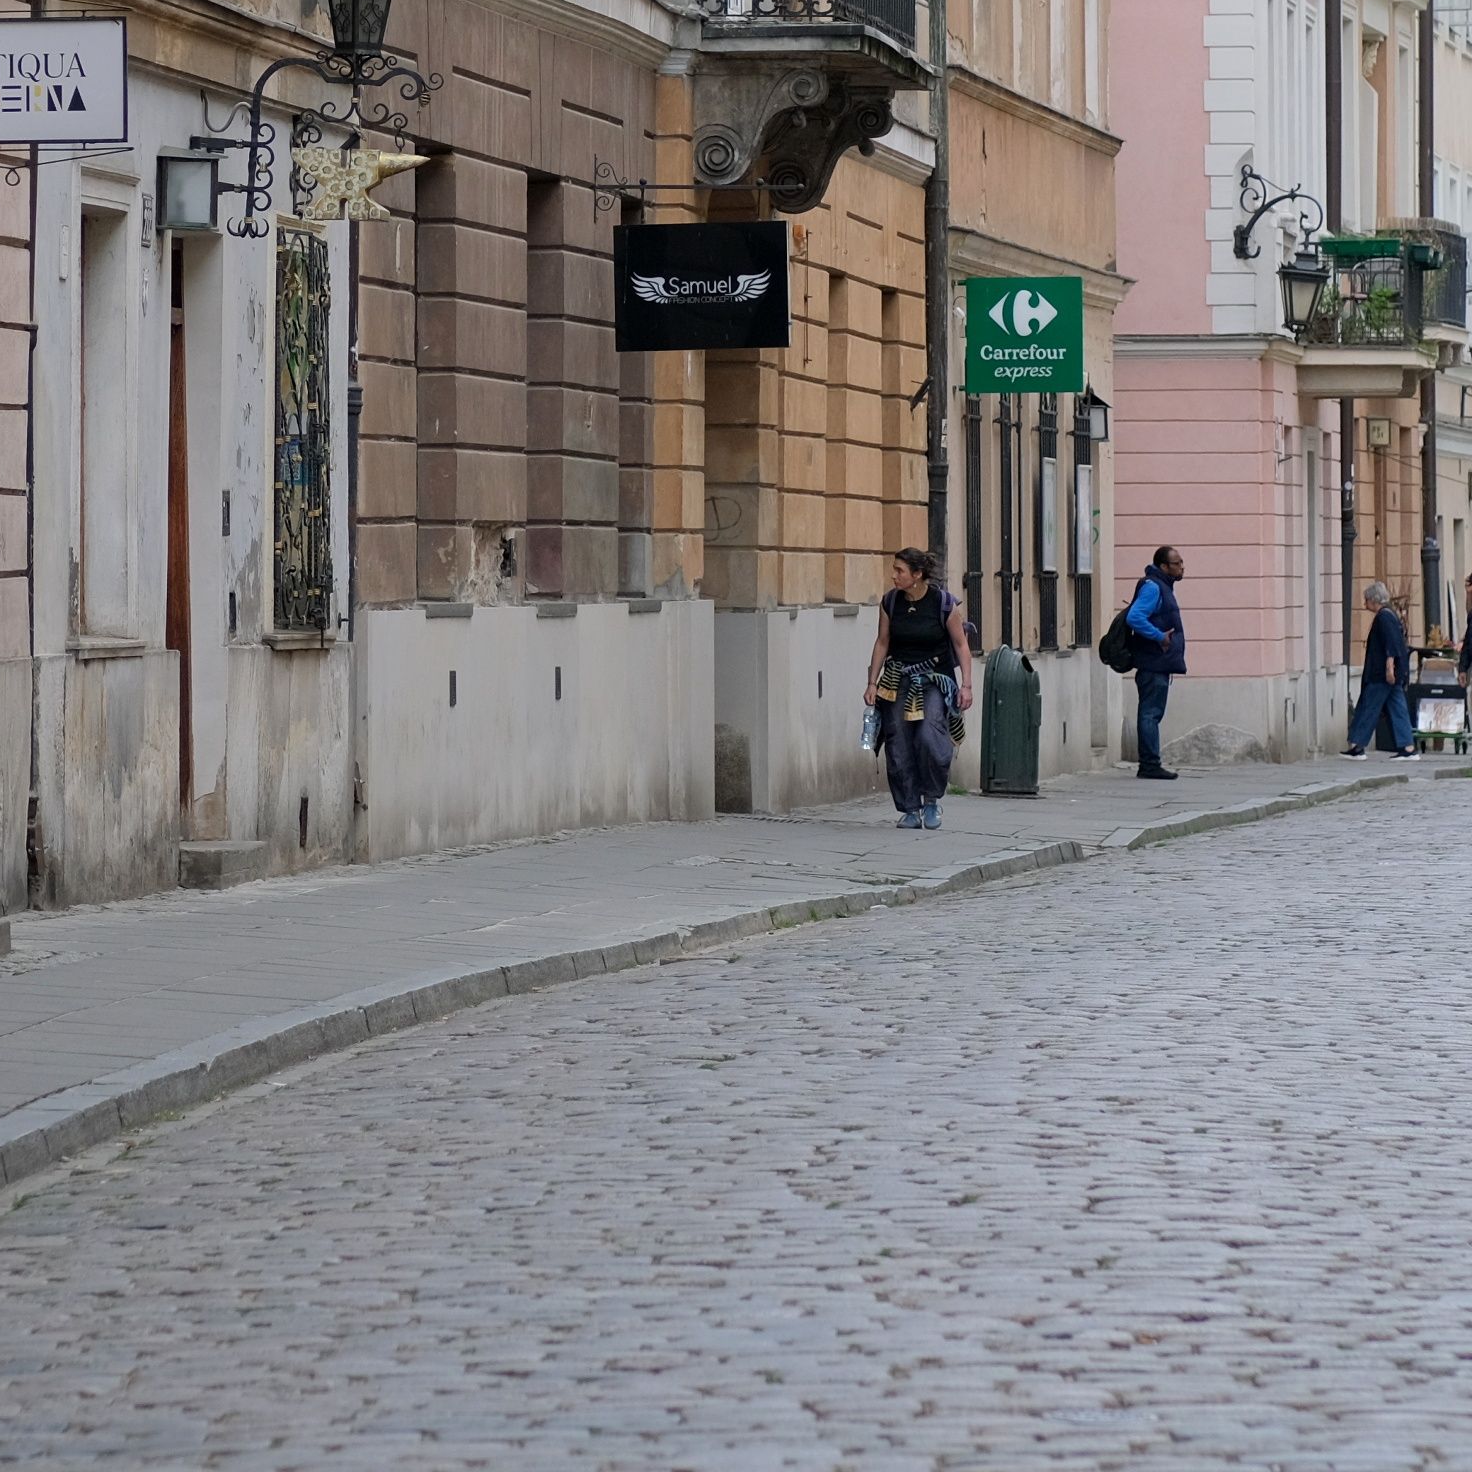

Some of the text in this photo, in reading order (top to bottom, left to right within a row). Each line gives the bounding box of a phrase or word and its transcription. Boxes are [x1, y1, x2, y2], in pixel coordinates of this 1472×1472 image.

[669, 275, 732, 295] Samuel
[668, 295, 735, 304] FASHION CONCEPT
[980, 343, 1067, 361] Carrefour
[994, 366, 1054, 384] express
